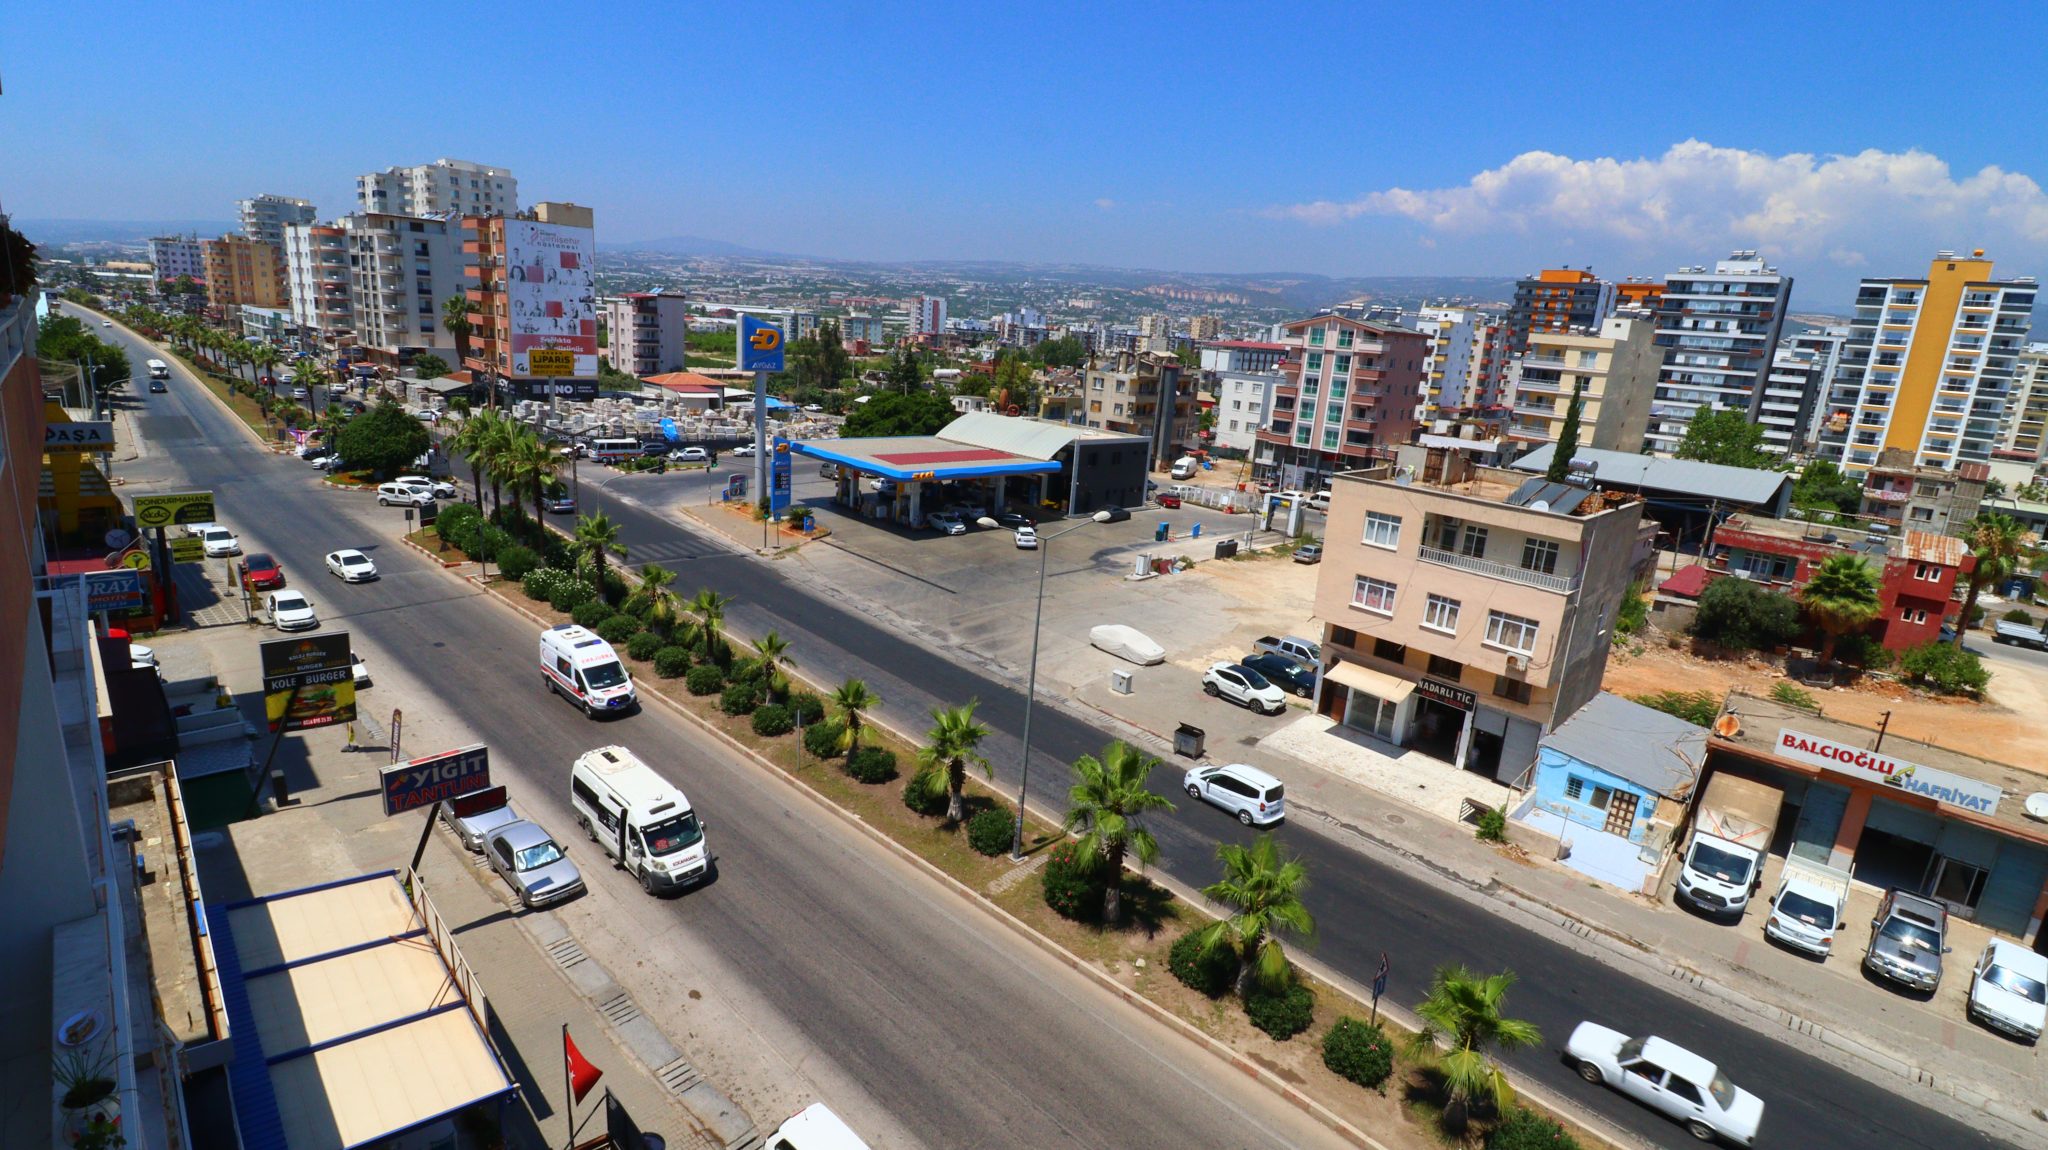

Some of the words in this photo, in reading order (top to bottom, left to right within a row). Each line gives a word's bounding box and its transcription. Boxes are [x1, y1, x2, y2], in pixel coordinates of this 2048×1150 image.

[543, 384, 574, 394] RNO
[45, 429, 101, 442] PAŞA
[136, 494, 211, 506] DONDURMAHANE
[296, 663, 323, 671] BURGER
[305, 670, 346, 684] BURGER
[1456, 692, 1473, 705] TİC.
[1782, 734, 1895, 775] BALCIOĞLU
[412, 754, 485, 788] YİĞİT
[390, 773, 487, 811] TANTUNİ
[1905, 777, 1992, 811] HAFRİYAT
